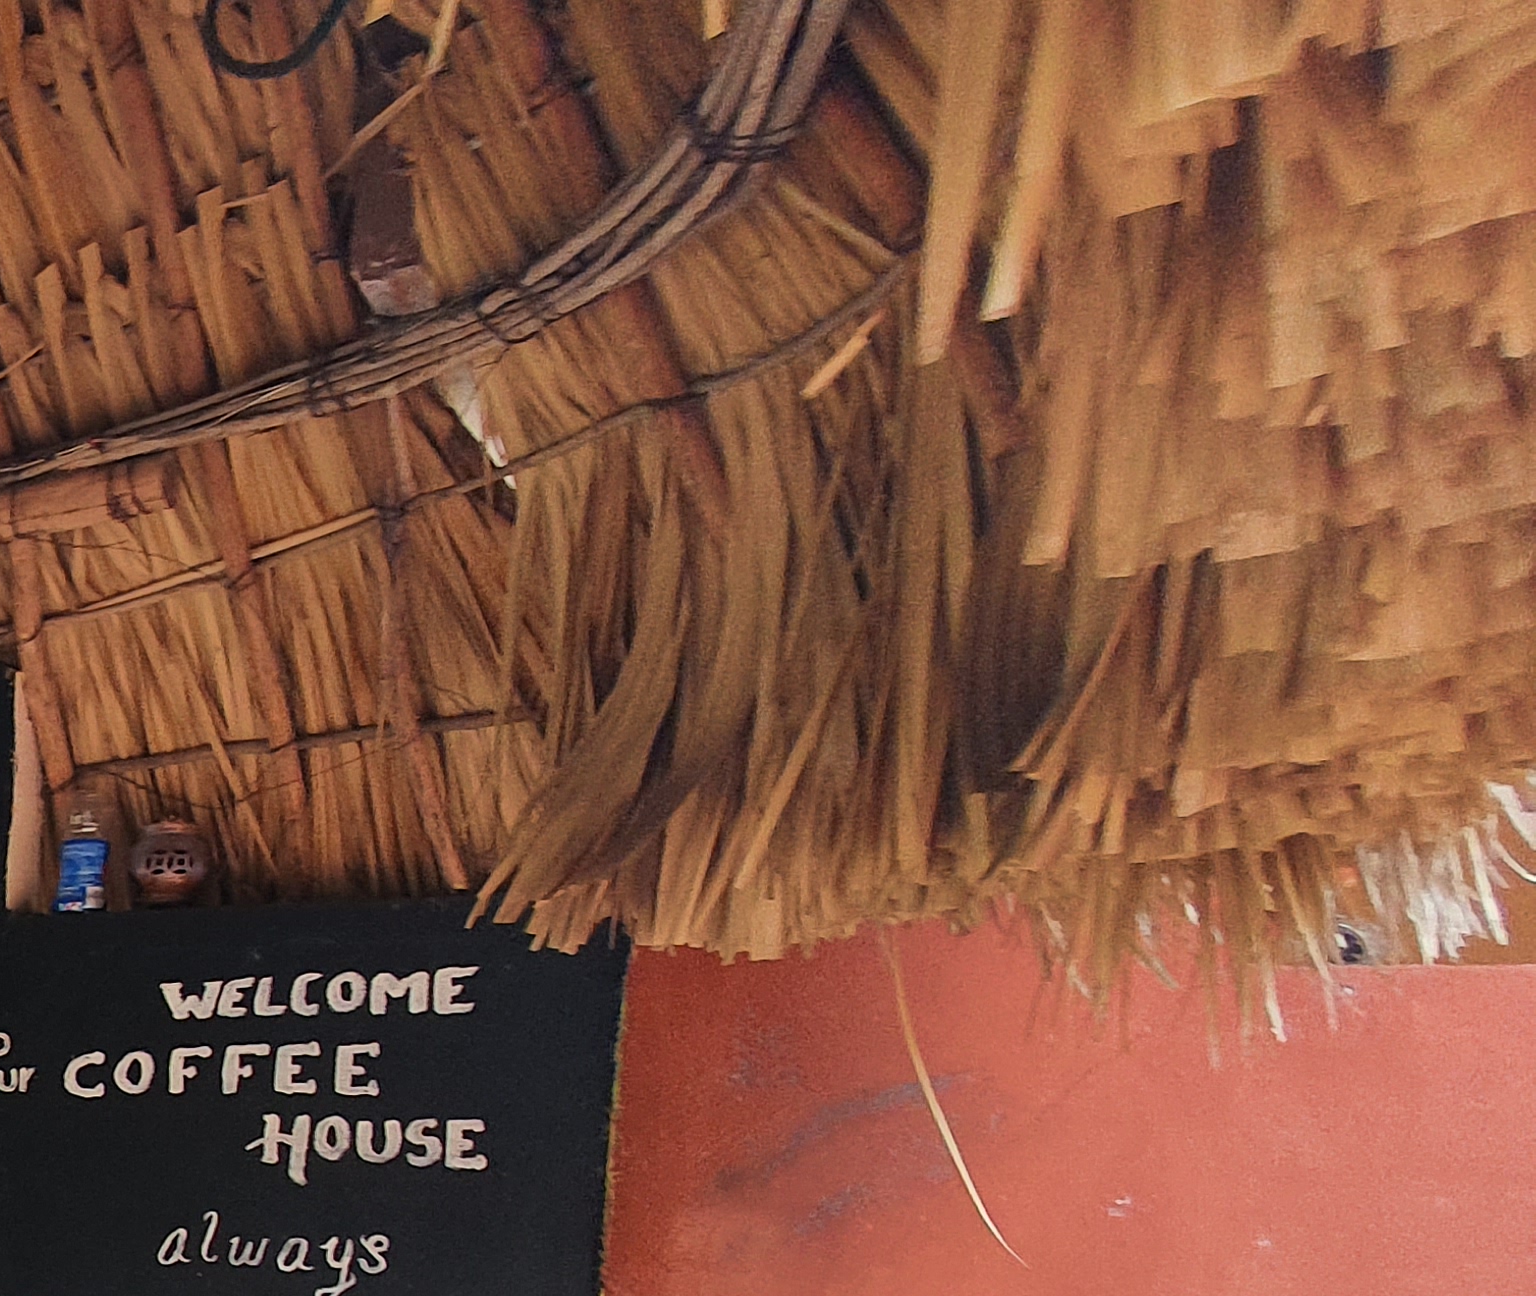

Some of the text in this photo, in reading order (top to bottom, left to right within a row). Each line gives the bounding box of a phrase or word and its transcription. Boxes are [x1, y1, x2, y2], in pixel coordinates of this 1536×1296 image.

[158, 965, 480, 1021] WELCOME
[62, 1041, 382, 1098] COFFEE
[244, 1112, 489, 1187] HOUSE
